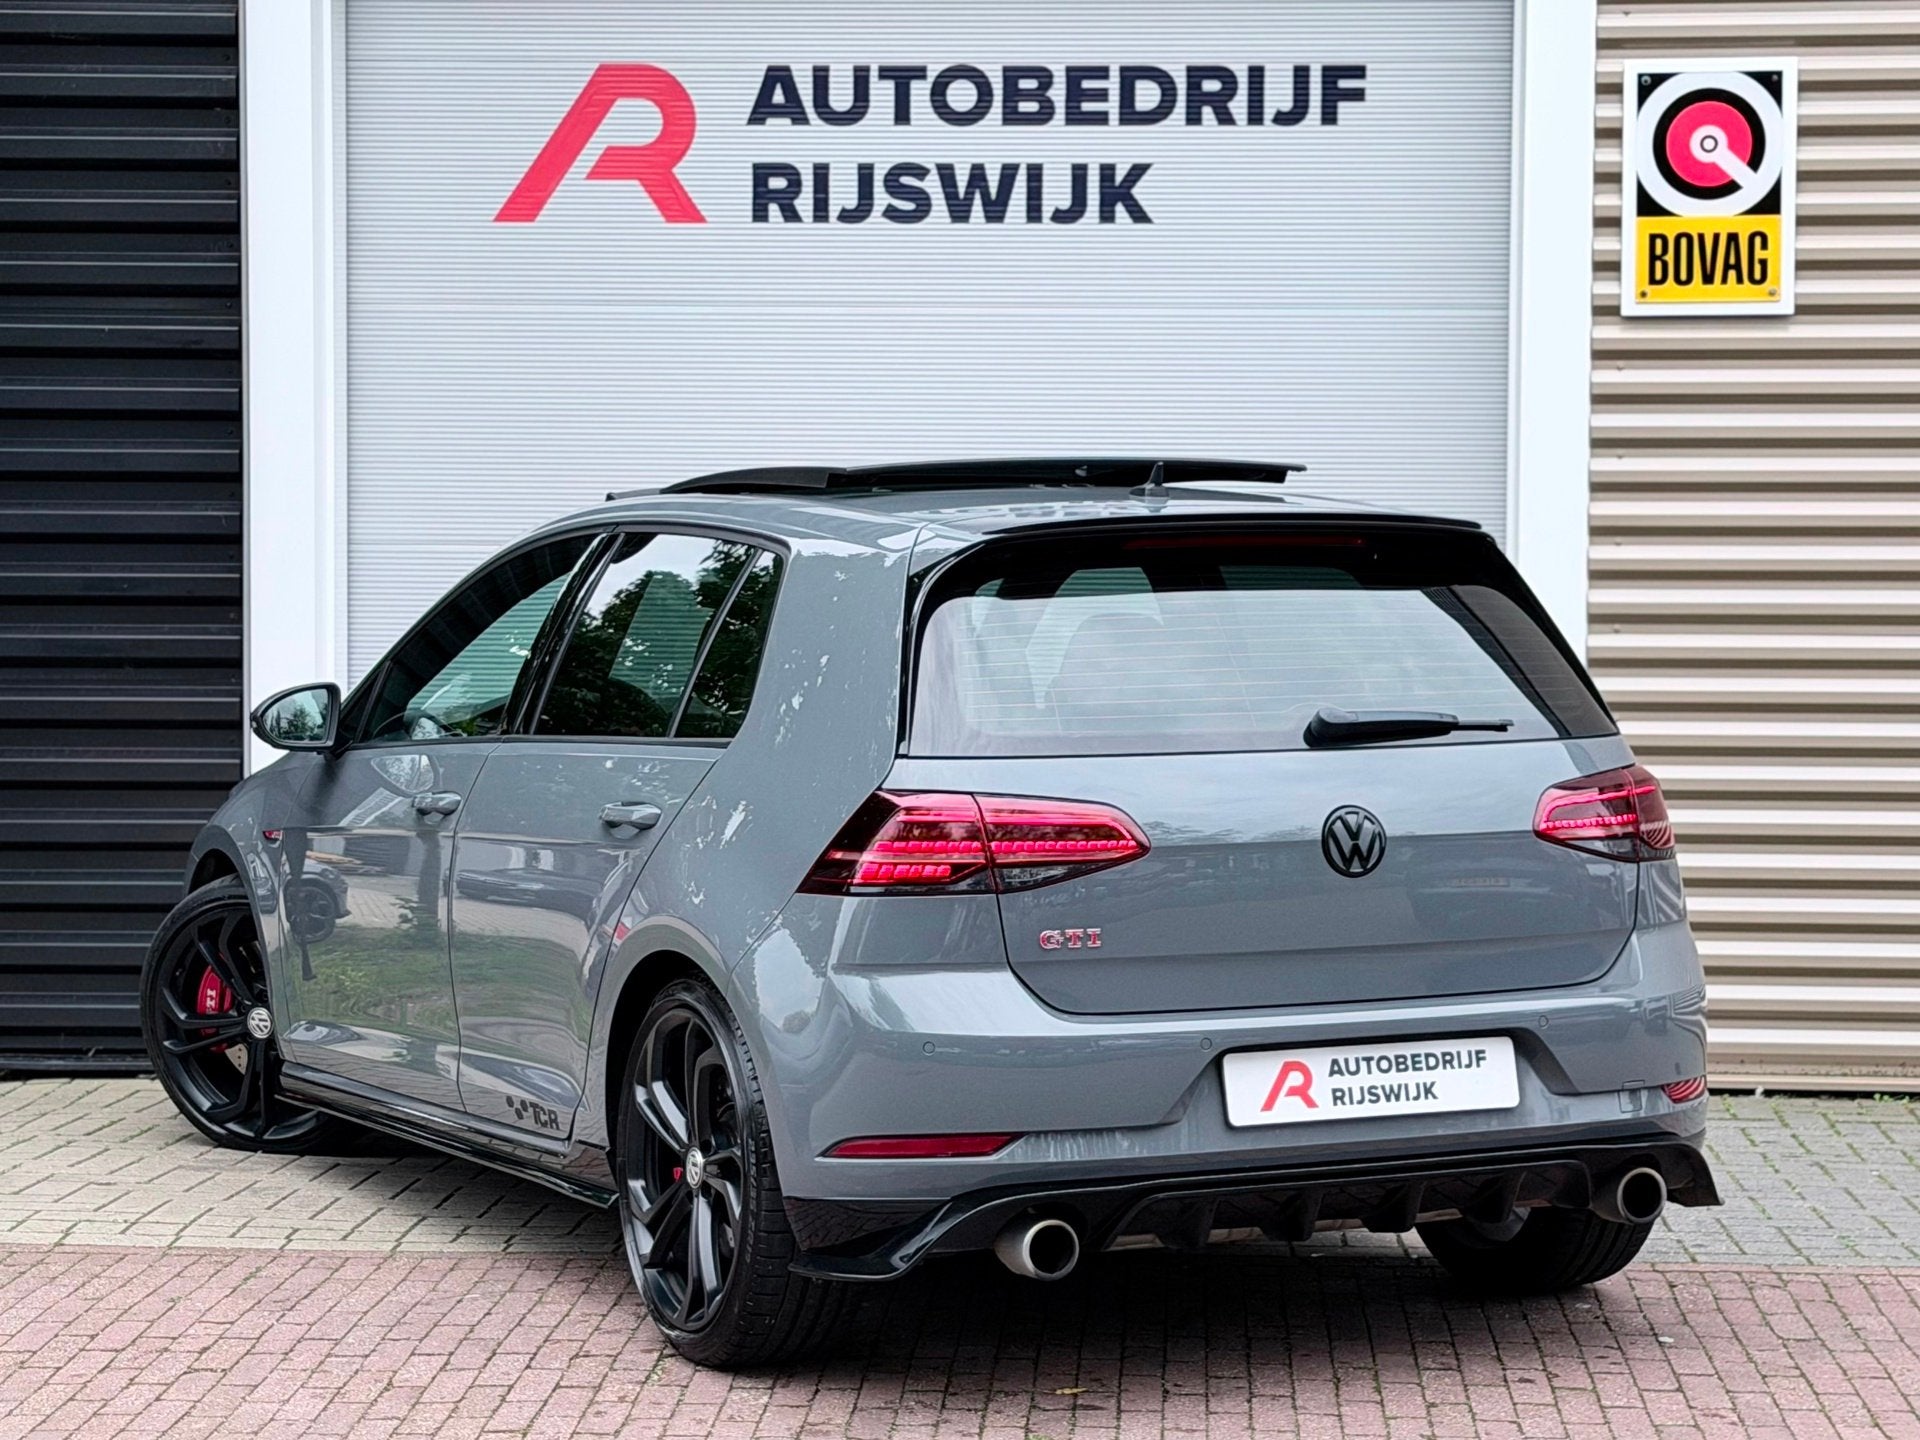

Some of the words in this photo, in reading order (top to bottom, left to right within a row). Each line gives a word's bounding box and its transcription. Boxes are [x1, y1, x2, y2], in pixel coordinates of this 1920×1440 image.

[747, 64, 1367, 127] AUTOBEDRIJF
[752, 162, 1154, 224] RIJSWIJK
[1648, 230, 1769, 286] BOVAG
[1039, 927, 1102, 950] GTI
[1328, 1049, 1488, 1078] AUTOBEDRIJF
[1331, 1081, 1439, 1107] RIJSWIJK
[528, 1101, 561, 1130] TCR
